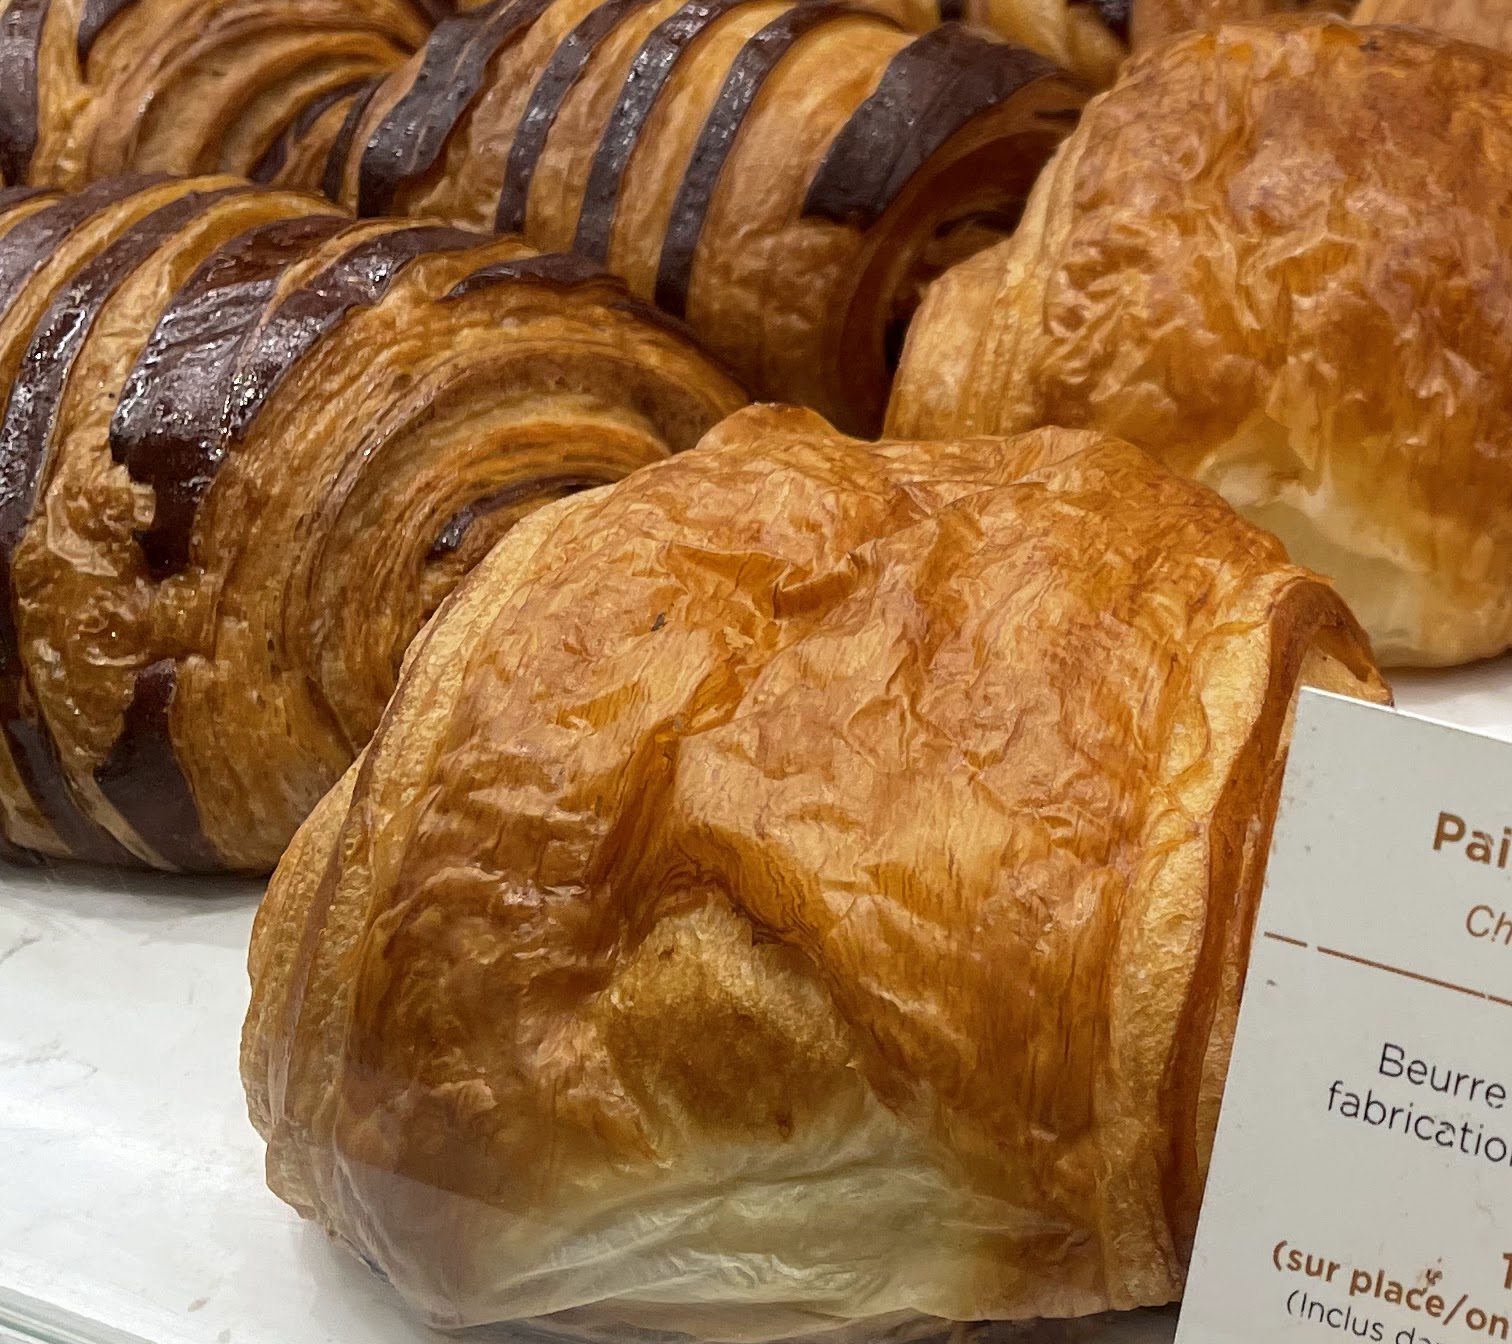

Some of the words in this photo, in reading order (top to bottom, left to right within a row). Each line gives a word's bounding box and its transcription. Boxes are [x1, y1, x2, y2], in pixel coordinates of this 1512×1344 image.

[1378, 1042, 1507, 1110] Beurre
[1273, 1240, 1340, 1283] (sur
[1349, 1269, 1510, 1340] place/on
[1287, 1290, 1384, 1342] (Inclus
